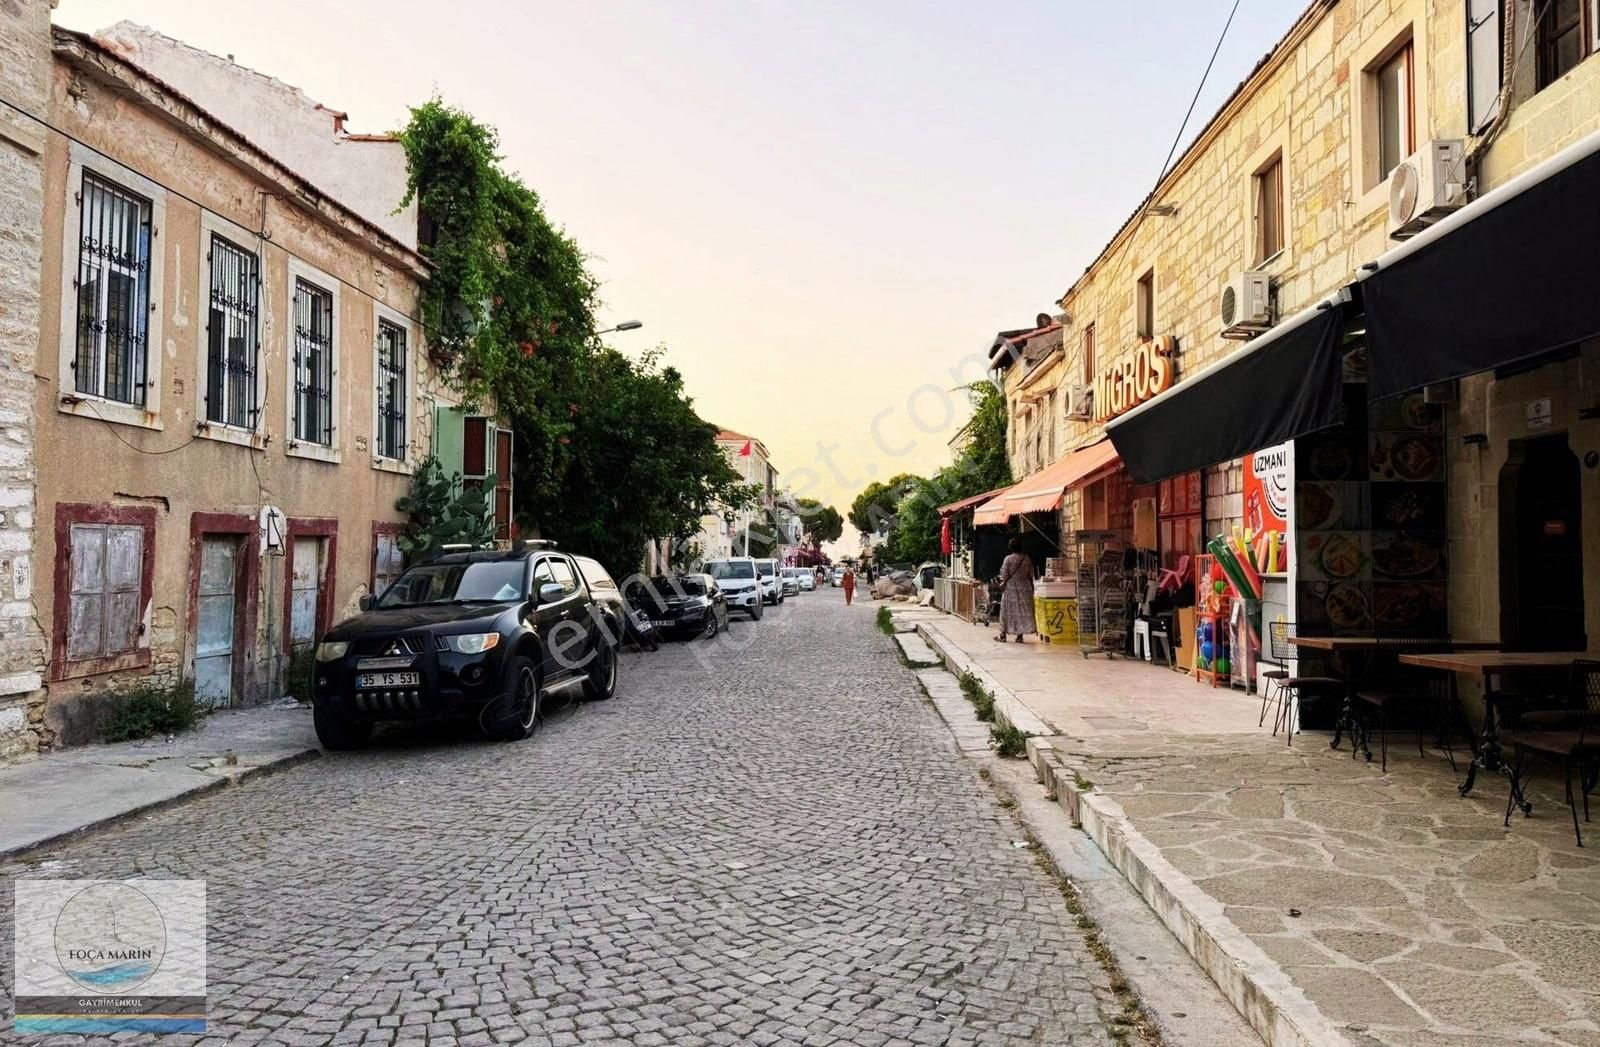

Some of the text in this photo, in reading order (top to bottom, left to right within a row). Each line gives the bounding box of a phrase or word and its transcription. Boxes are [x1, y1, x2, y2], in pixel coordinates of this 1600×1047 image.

[1254, 451, 1286, 473] UZMANI
[362, 673, 418, 685] 35 YS 531
